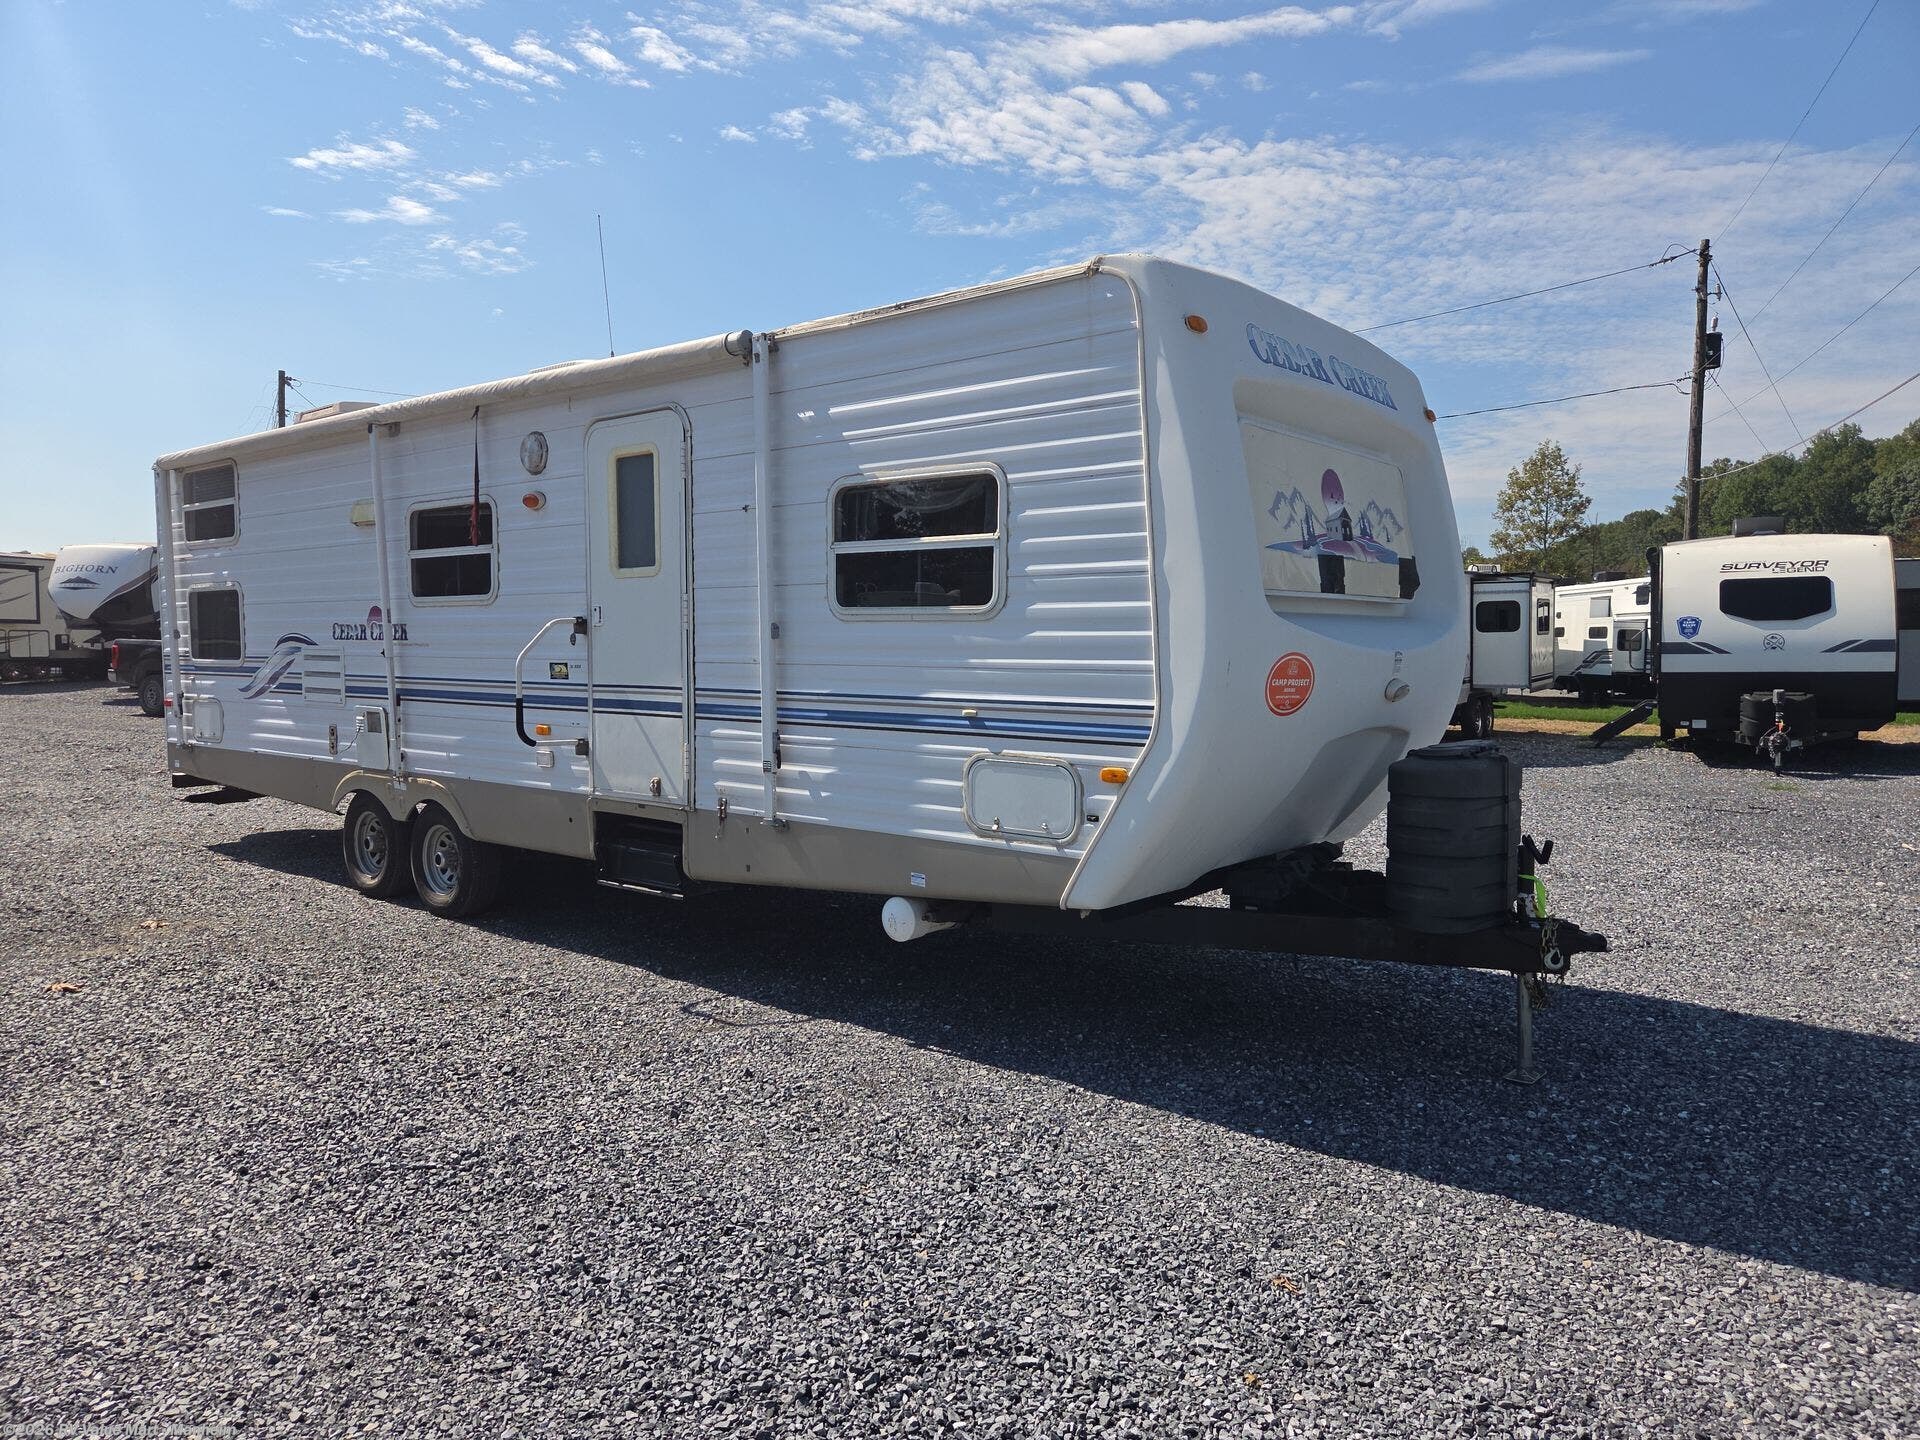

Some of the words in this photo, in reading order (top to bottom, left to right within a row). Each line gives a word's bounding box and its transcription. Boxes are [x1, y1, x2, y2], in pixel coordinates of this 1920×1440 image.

[1246, 322, 1334, 385] CEDAR
[1328, 355, 1398, 411] CREEK
[55, 564, 119, 574] BIGHORN
[1720, 560, 1829, 571] SURVEYOR
[1771, 566, 1825, 574] LEGEND
[332, 622, 368, 641] CEDAR
[370, 621, 409, 641] CREK
